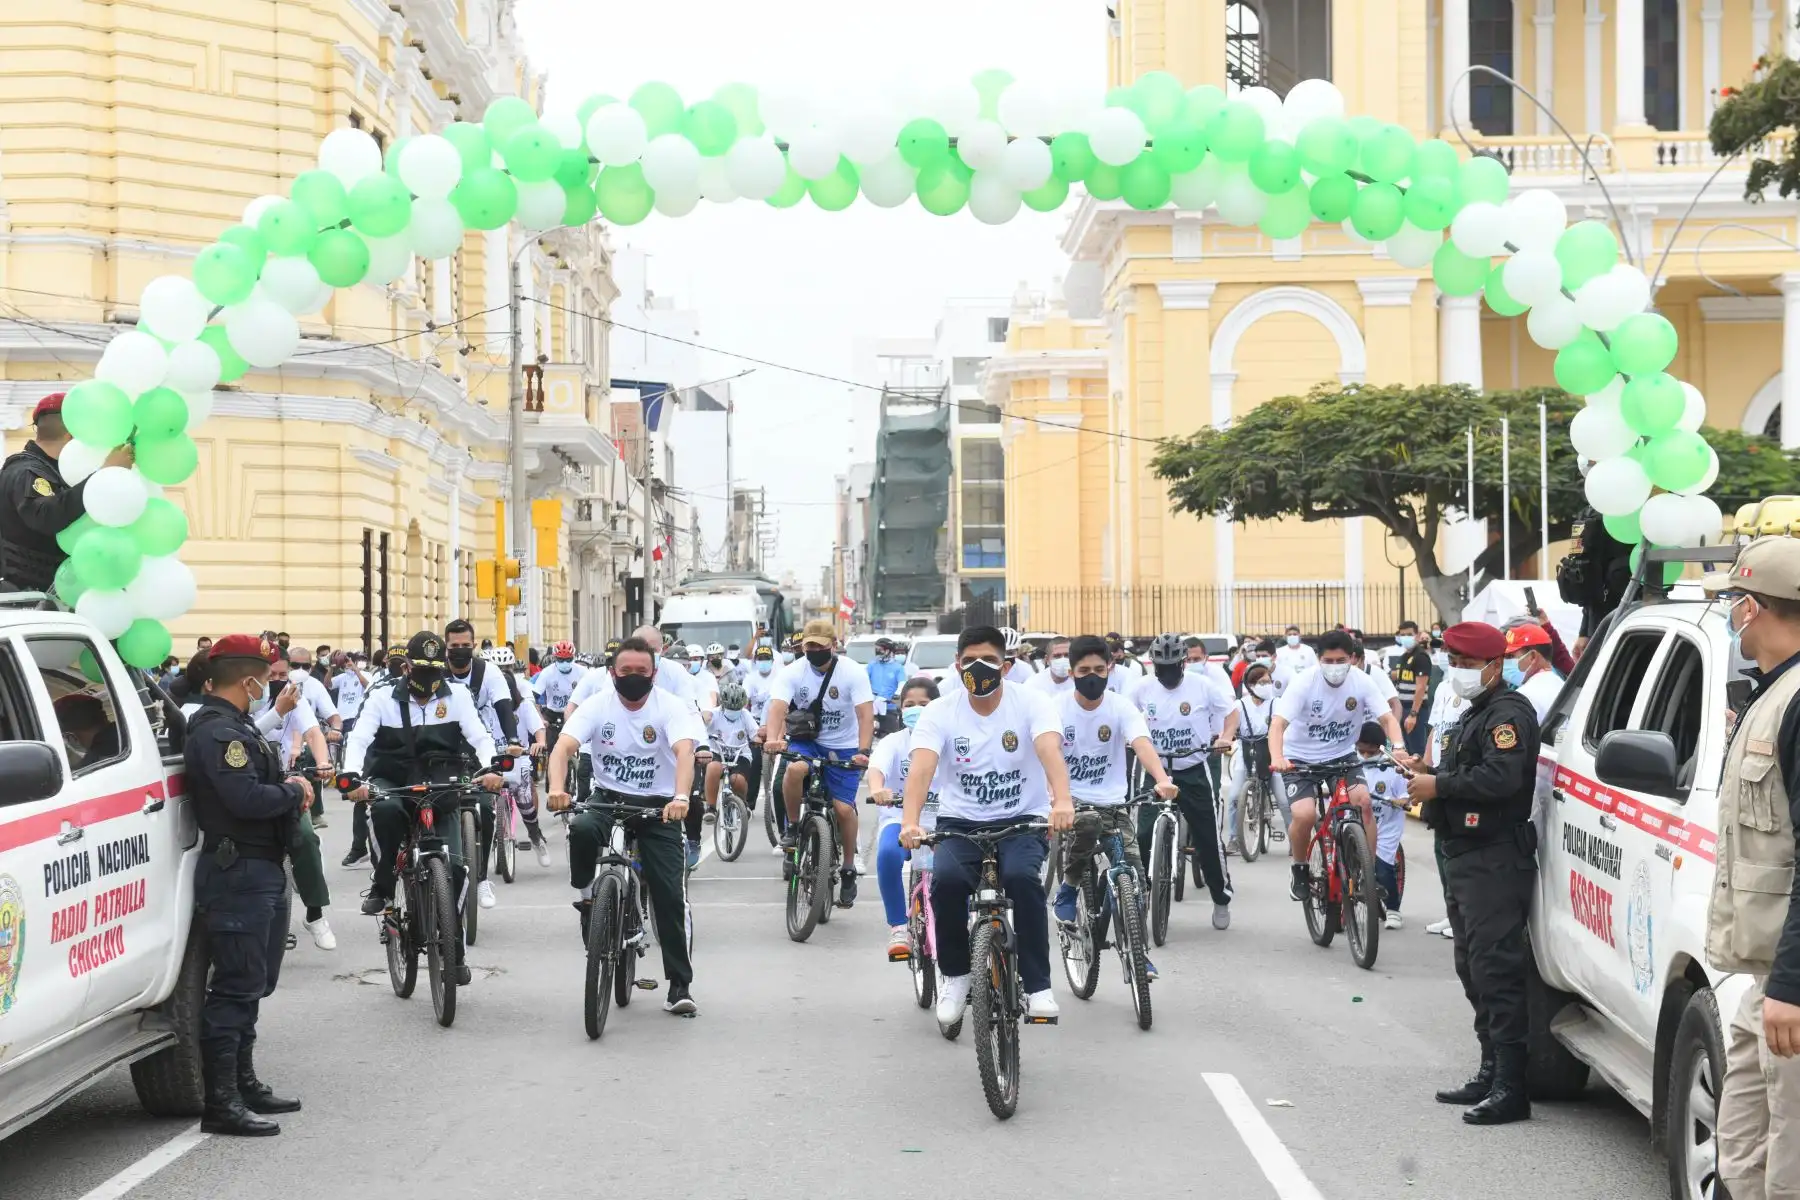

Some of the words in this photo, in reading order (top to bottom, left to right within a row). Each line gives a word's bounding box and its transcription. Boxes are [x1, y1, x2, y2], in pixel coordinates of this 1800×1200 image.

[1167, 727, 1192, 739] Rosa
[624, 755, 655, 768] Rosa
[985, 769, 1021, 788] Rosa
[1080, 754, 1108, 770] Rosa
[43, 850, 91, 898] POLICIA
[97, 832, 150, 877] NACIONAL
[1563, 821, 1587, 863] POLICIA
[1587, 834, 1622, 881] NACIONAL
[50, 899, 88, 944] RADIO
[94, 878, 146, 927] PATRULLA
[1570, 869, 1616, 950] RESCATE
[68, 924, 125, 978] CHICLAYO
